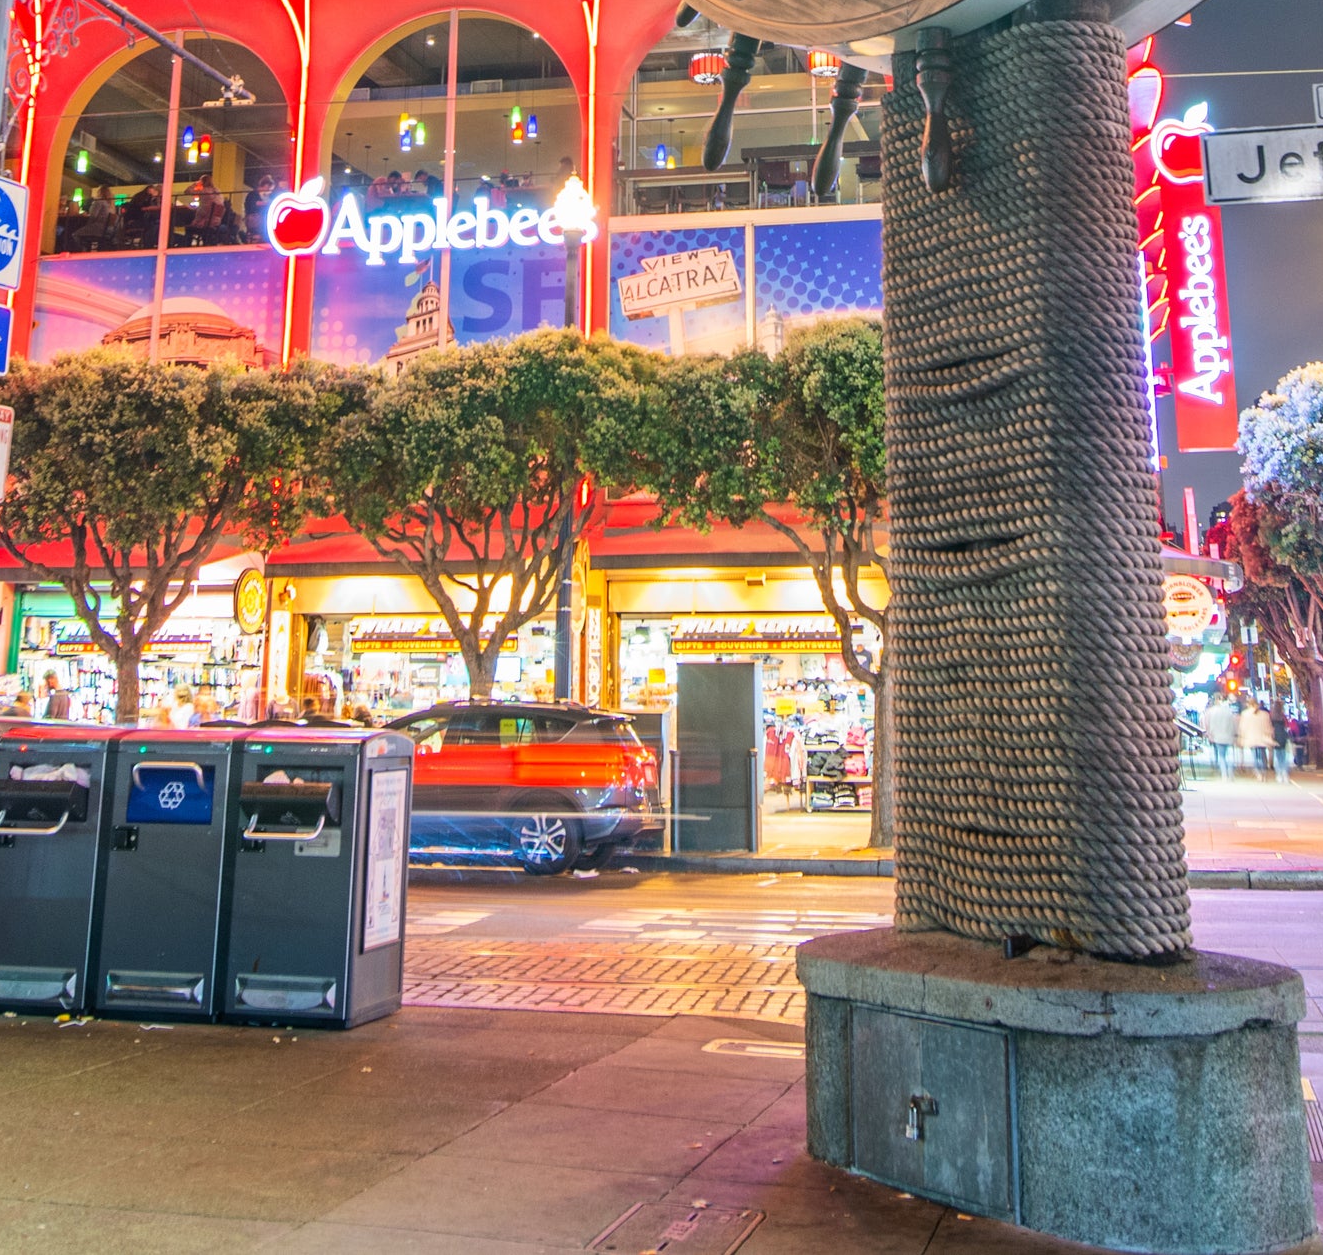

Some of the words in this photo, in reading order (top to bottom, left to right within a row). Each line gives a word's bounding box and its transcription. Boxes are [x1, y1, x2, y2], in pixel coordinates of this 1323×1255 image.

[322, 192, 599, 266] Applebees
[644, 250, 701, 273] VIEW
[622, 261, 734, 303] ALCATRAZ
[1177, 215, 1228, 405] Applebee's
[1164, 580, 1204, 597] ORNBLOWER
[59, 643, 85, 652] GIFTS
[355, 641, 382, 649] GIFTS
[391, 641, 443, 649] SOUVENIRS
[588, 634, 602, 707] BILLABON
